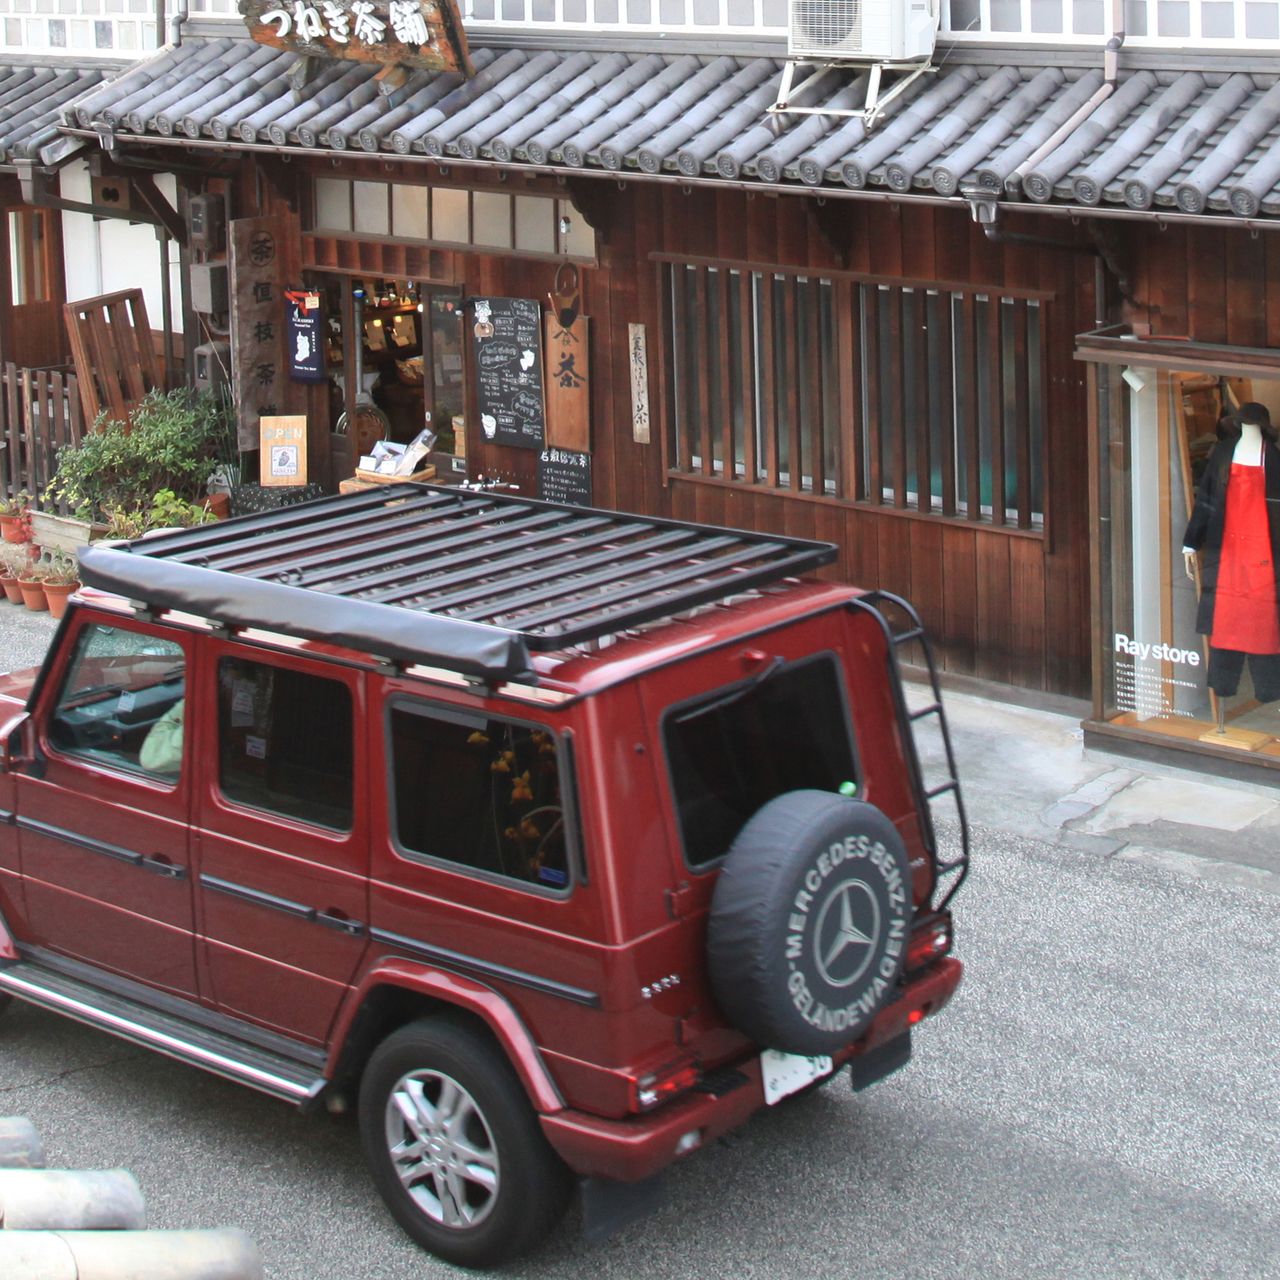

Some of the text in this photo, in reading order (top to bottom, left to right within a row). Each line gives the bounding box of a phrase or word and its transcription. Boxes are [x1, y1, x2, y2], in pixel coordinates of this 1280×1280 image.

[260, 0, 429, 46] つねき茶舗
[250, 238, 274, 261] 茶
[553, 352, 586, 388] 茶
[264, 427, 303, 440] OPEN
[1114, 633, 1200, 666] Ray store
[785, 835, 906, 958] MERCEDES-BENZ
